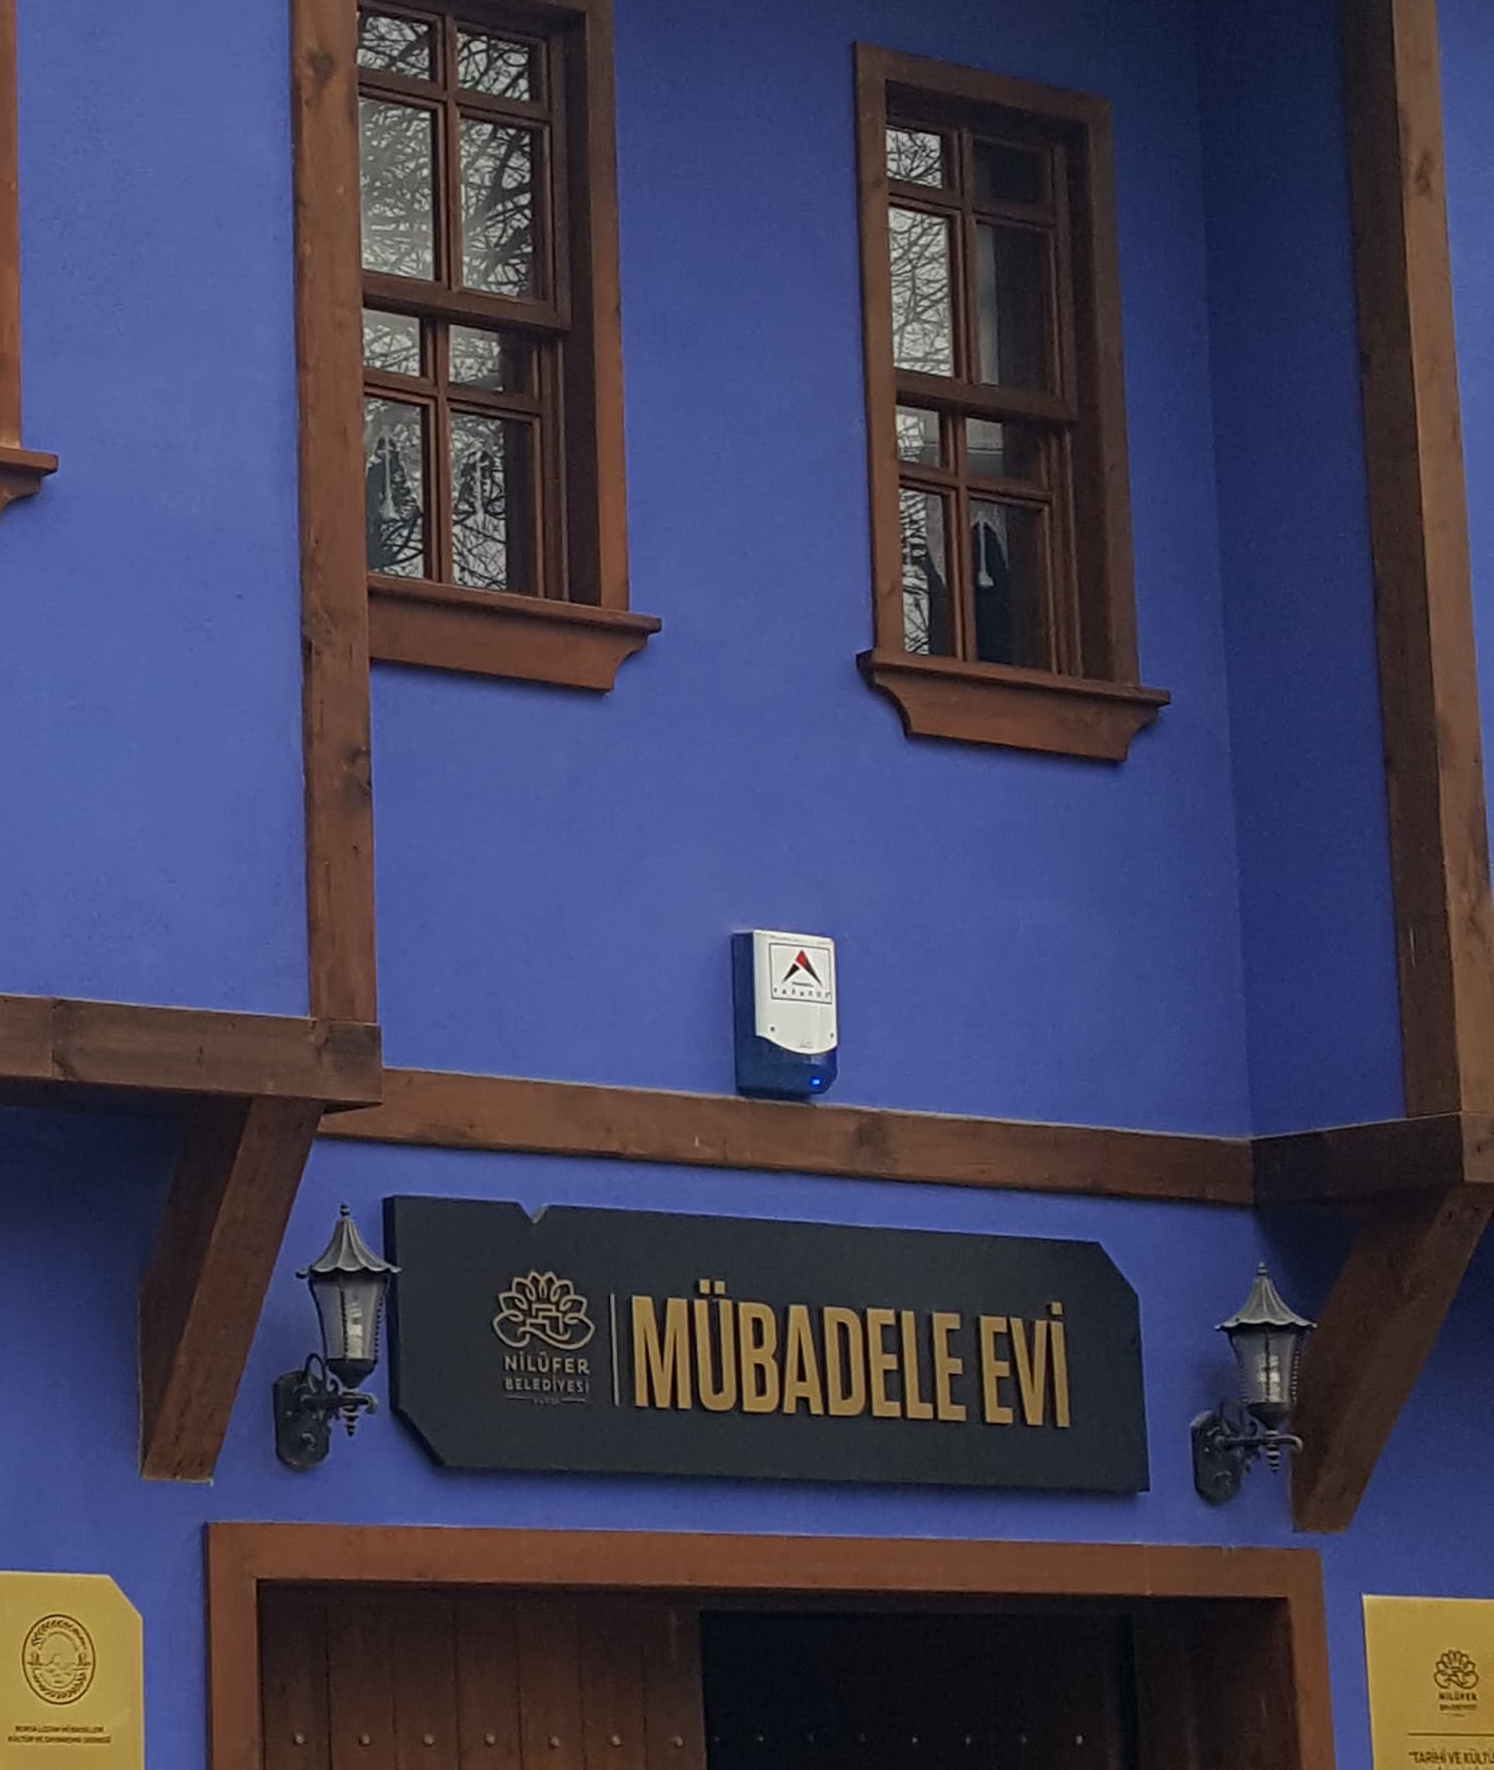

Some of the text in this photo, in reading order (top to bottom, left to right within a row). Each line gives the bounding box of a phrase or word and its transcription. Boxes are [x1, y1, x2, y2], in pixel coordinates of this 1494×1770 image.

[504, 1350, 590, 1375] NİLÜFER
[631, 1278, 1071, 1428] MÜBADELE EVİ
